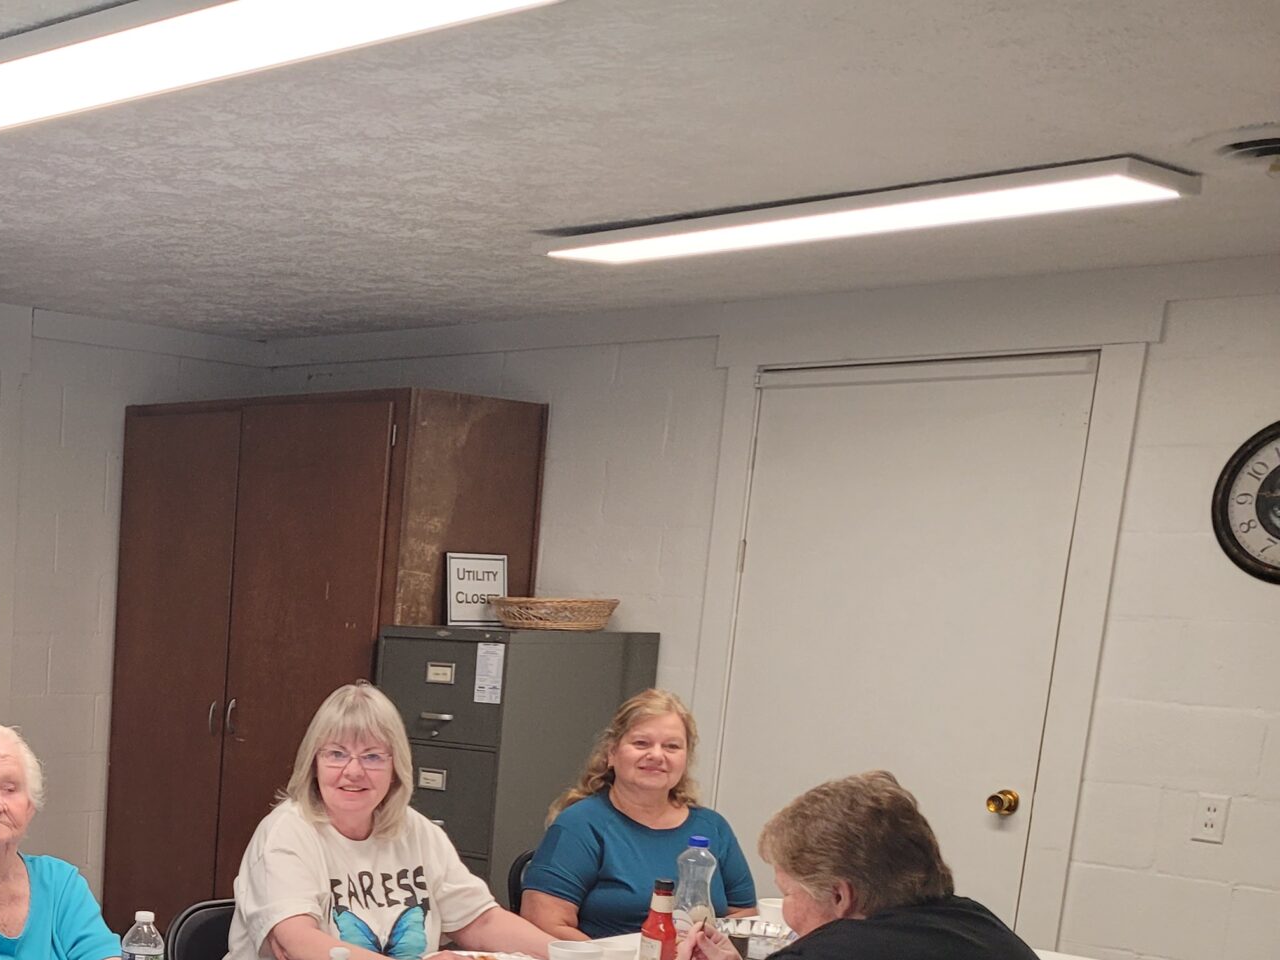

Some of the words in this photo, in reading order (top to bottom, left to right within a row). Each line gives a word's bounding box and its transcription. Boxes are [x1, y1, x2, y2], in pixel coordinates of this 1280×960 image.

[1247, 461, 1269, 481] 10
[1236, 493, 1254, 505] 9
[1239, 519, 1257, 533] 8
[1260, 537, 1278, 553] 7
[456, 567, 498, 582] UTILITY
